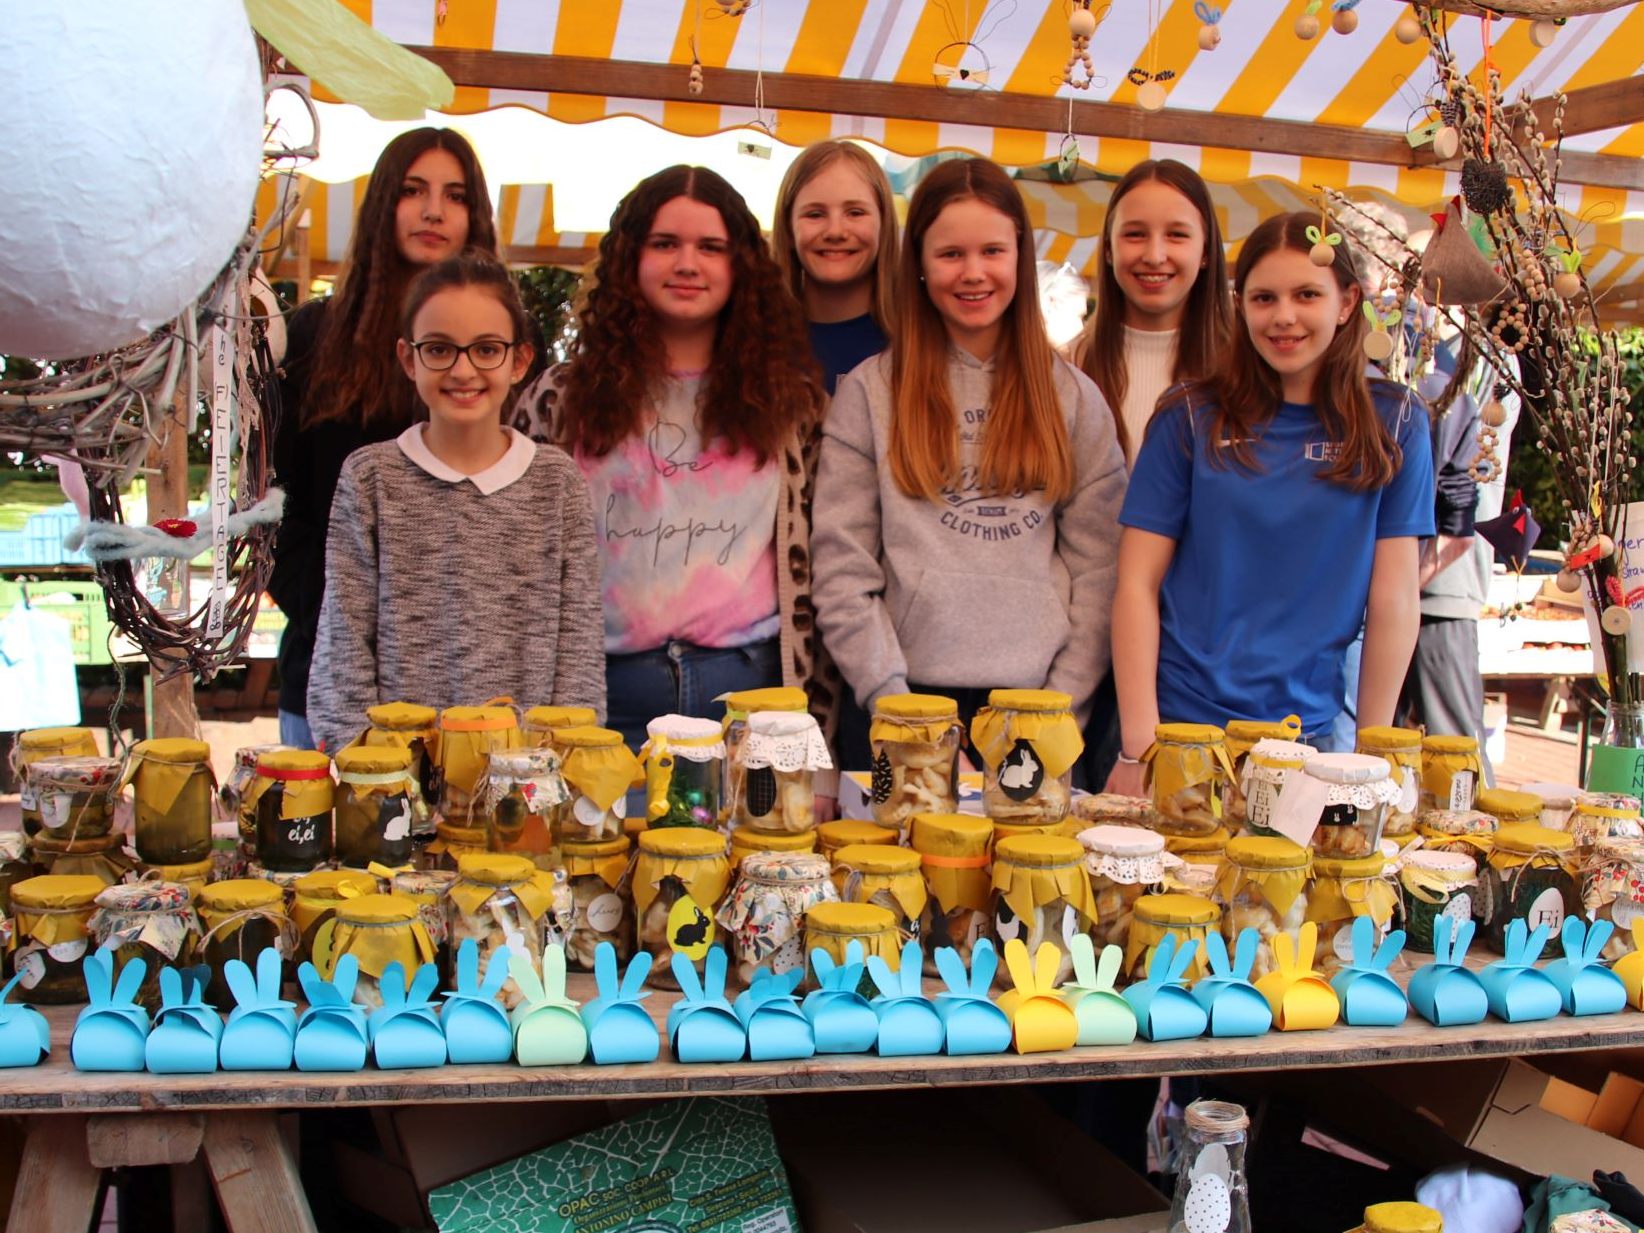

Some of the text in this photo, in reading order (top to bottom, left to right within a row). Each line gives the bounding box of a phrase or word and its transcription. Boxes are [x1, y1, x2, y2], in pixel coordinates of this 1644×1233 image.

[648, 417, 713, 478] Be
[605, 493, 748, 567] happy
[940, 511, 1021, 541] CLOTHING
[1256, 791, 1269, 805] Ei
[1252, 804, 1269, 825] Ei
[1538, 909, 1559, 929] Ei
[559, 1192, 600, 1217] OPAC
[631, 1193, 672, 1216] CAMPISI
